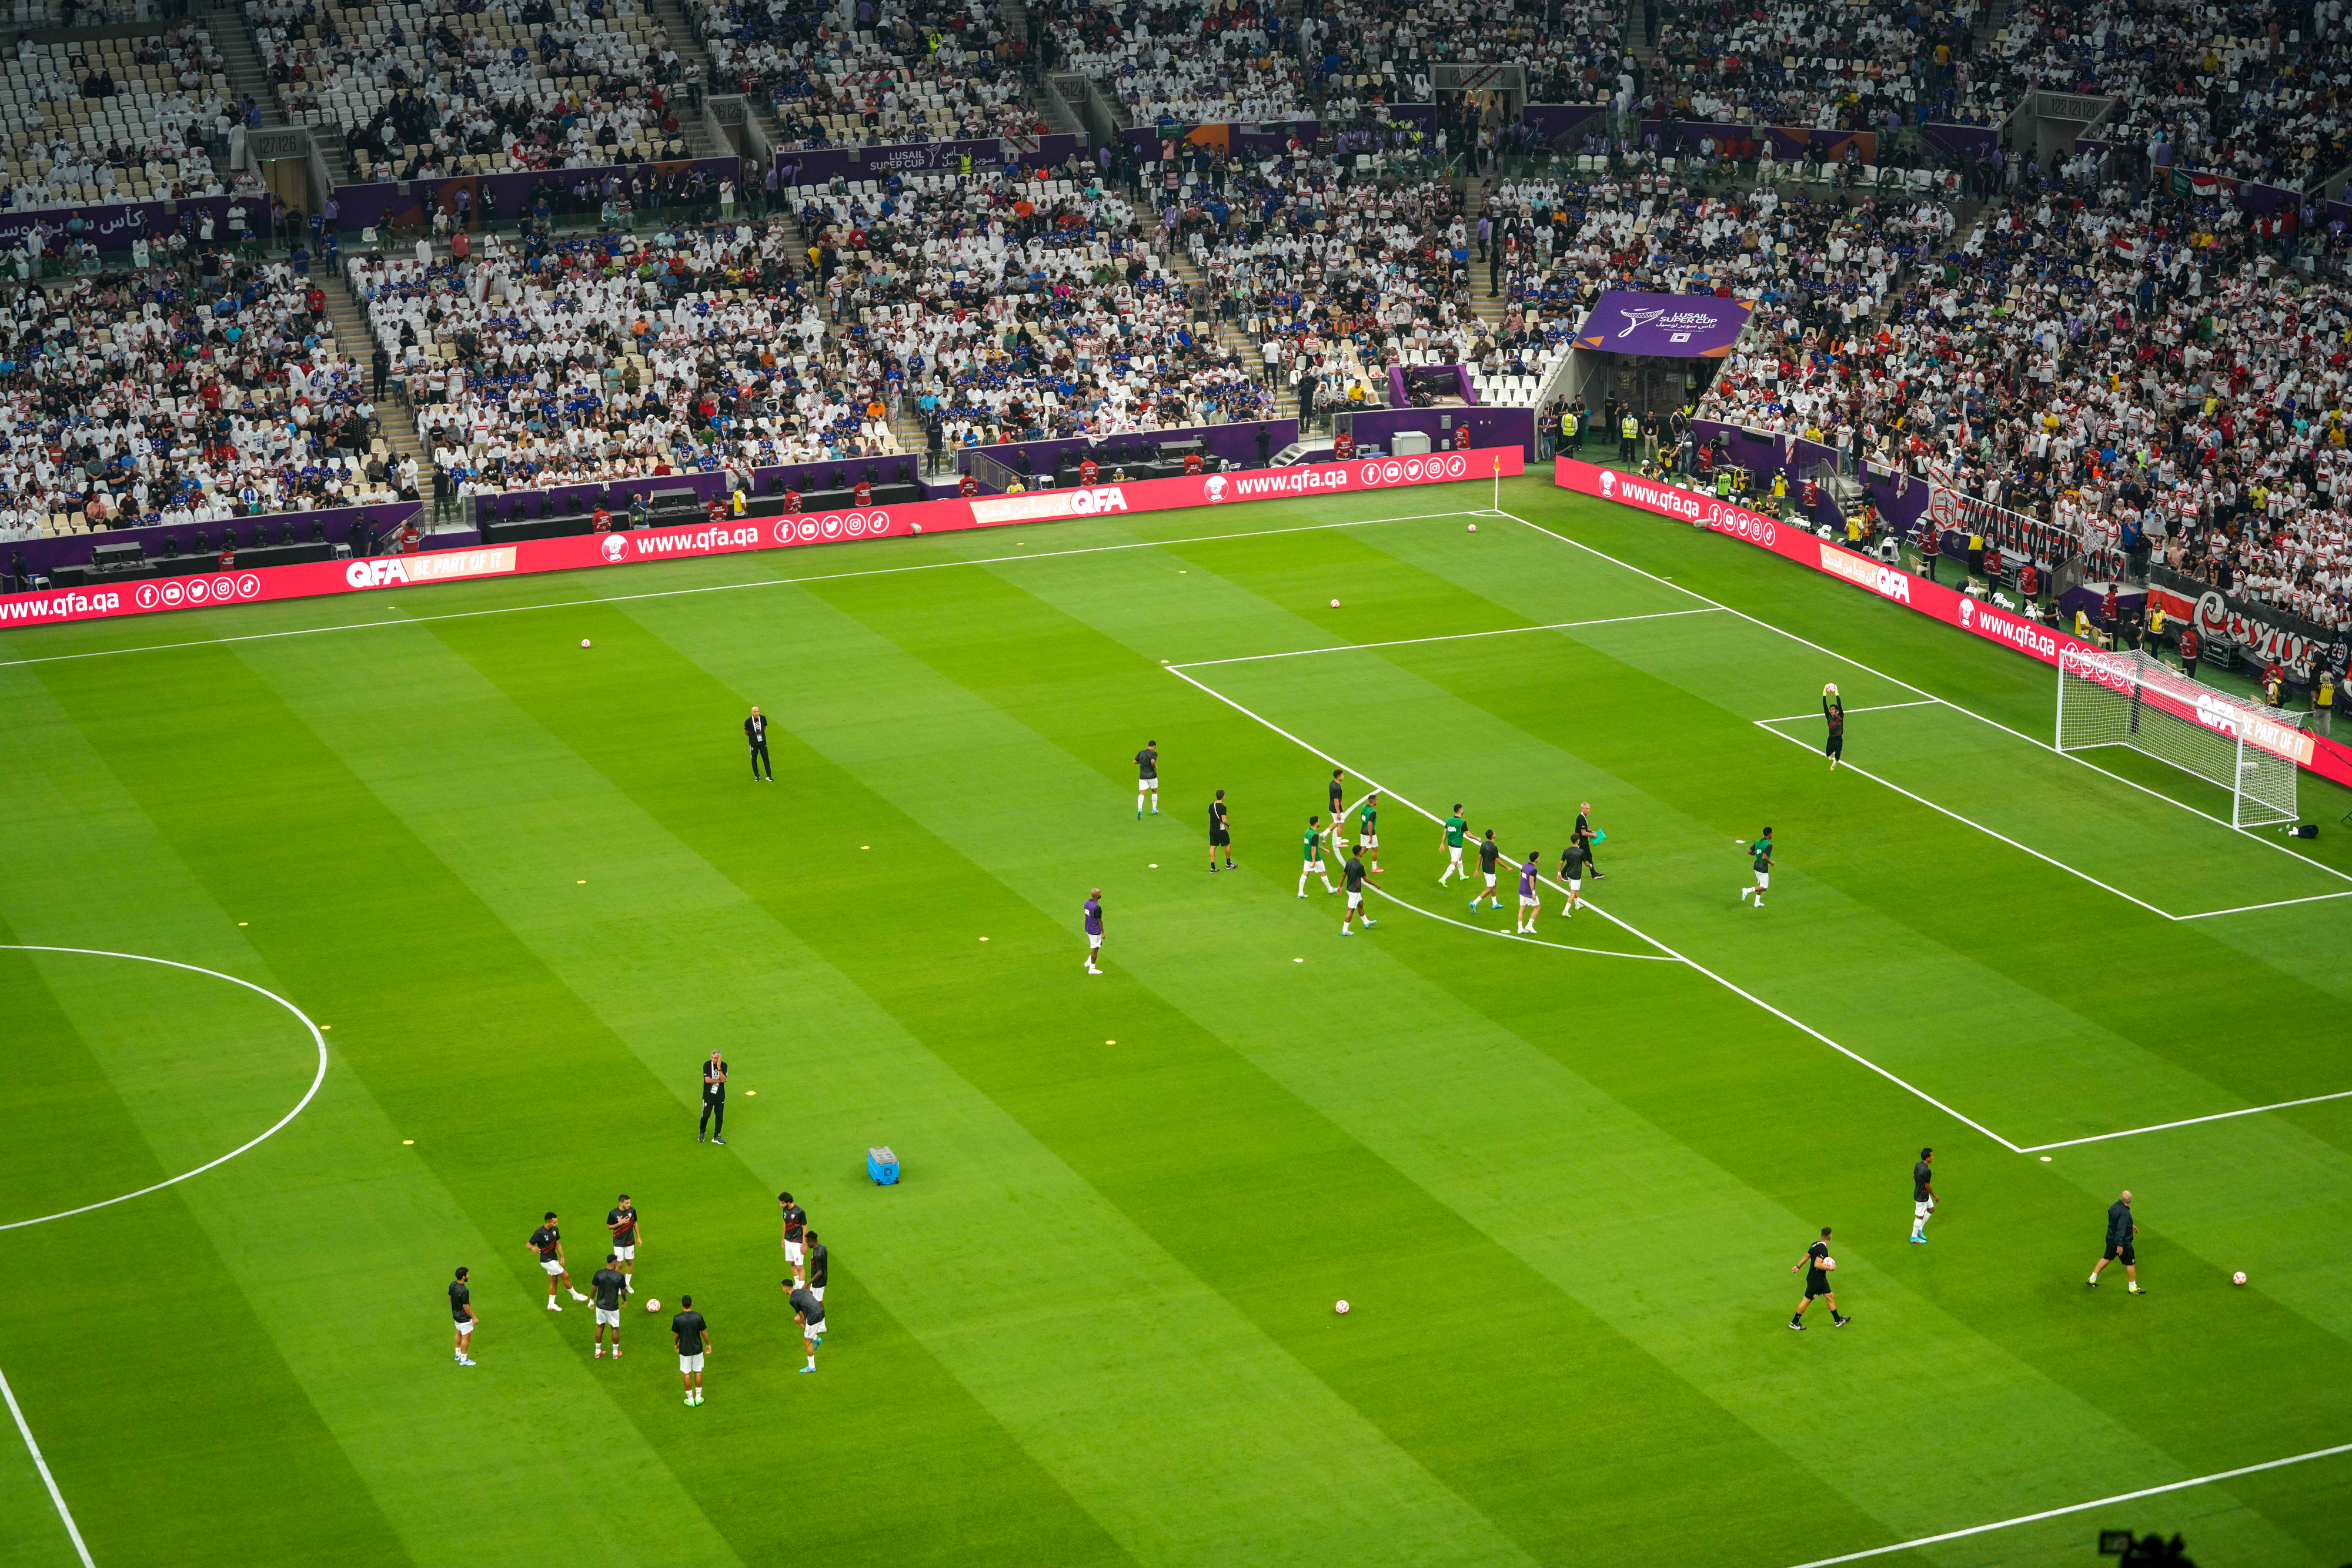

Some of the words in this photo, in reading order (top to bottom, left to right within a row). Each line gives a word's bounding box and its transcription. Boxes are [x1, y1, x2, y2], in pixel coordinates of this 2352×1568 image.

[1450, 70, 1461, 85] 12
[1055, 82, 1068, 97] 25
[1068, 81, 1084, 96] 124
[710, 105, 724, 119] 26
[727, 103, 741, 119] 125
[2052, 98, 2067, 114] 122
[2069, 99, 2081, 116] 121
[2082, 101, 2098, 118] 120
[258, 137, 275, 153] 127
[278, 135, 296, 152] 126
[889, 151, 924, 160] LUSAIL
[974, 157, 995, 166] سوبر
[870, 161, 901, 170] SUPER
[903, 159, 924, 168] CUP
[2316, 198, 2324, 208] 120
[100, 206, 143, 234] كأس
[1237, 469, 1347, 494] www.qfa.qa
[1071, 487, 1128, 514] QFA
[1622, 482, 1699, 518] www.qfa.qa
[978, 504, 1011, 518] الحدث
[1013, 506, 1028, 517] من
[637, 527, 758, 554] www.qfa.qa
[1960, 497, 2025, 556] ZAMALEK
[2084, 547, 2124, 583] ANS
[1823, 552, 1842, 569] الحدث
[1843, 563, 1852, 574] من
[346, 558, 409, 587] QFA
[413, 560, 430, 576] BE
[434, 556, 467, 574] PART
[470, 553, 487, 570] OF
[490, 552, 503, 569] IT
[1876, 567, 1910, 604] QFA
[1980, 611, 2054, 657] www.qfa.qa
[2332, 642, 2344, 658] 20
[2196, 694, 2237, 735] QFA
[2242, 716, 2252, 736] BE
[2254, 721, 2279, 745] PART
[2280, 731, 2294, 751] OF
[2294, 737, 2305, 756] IT
